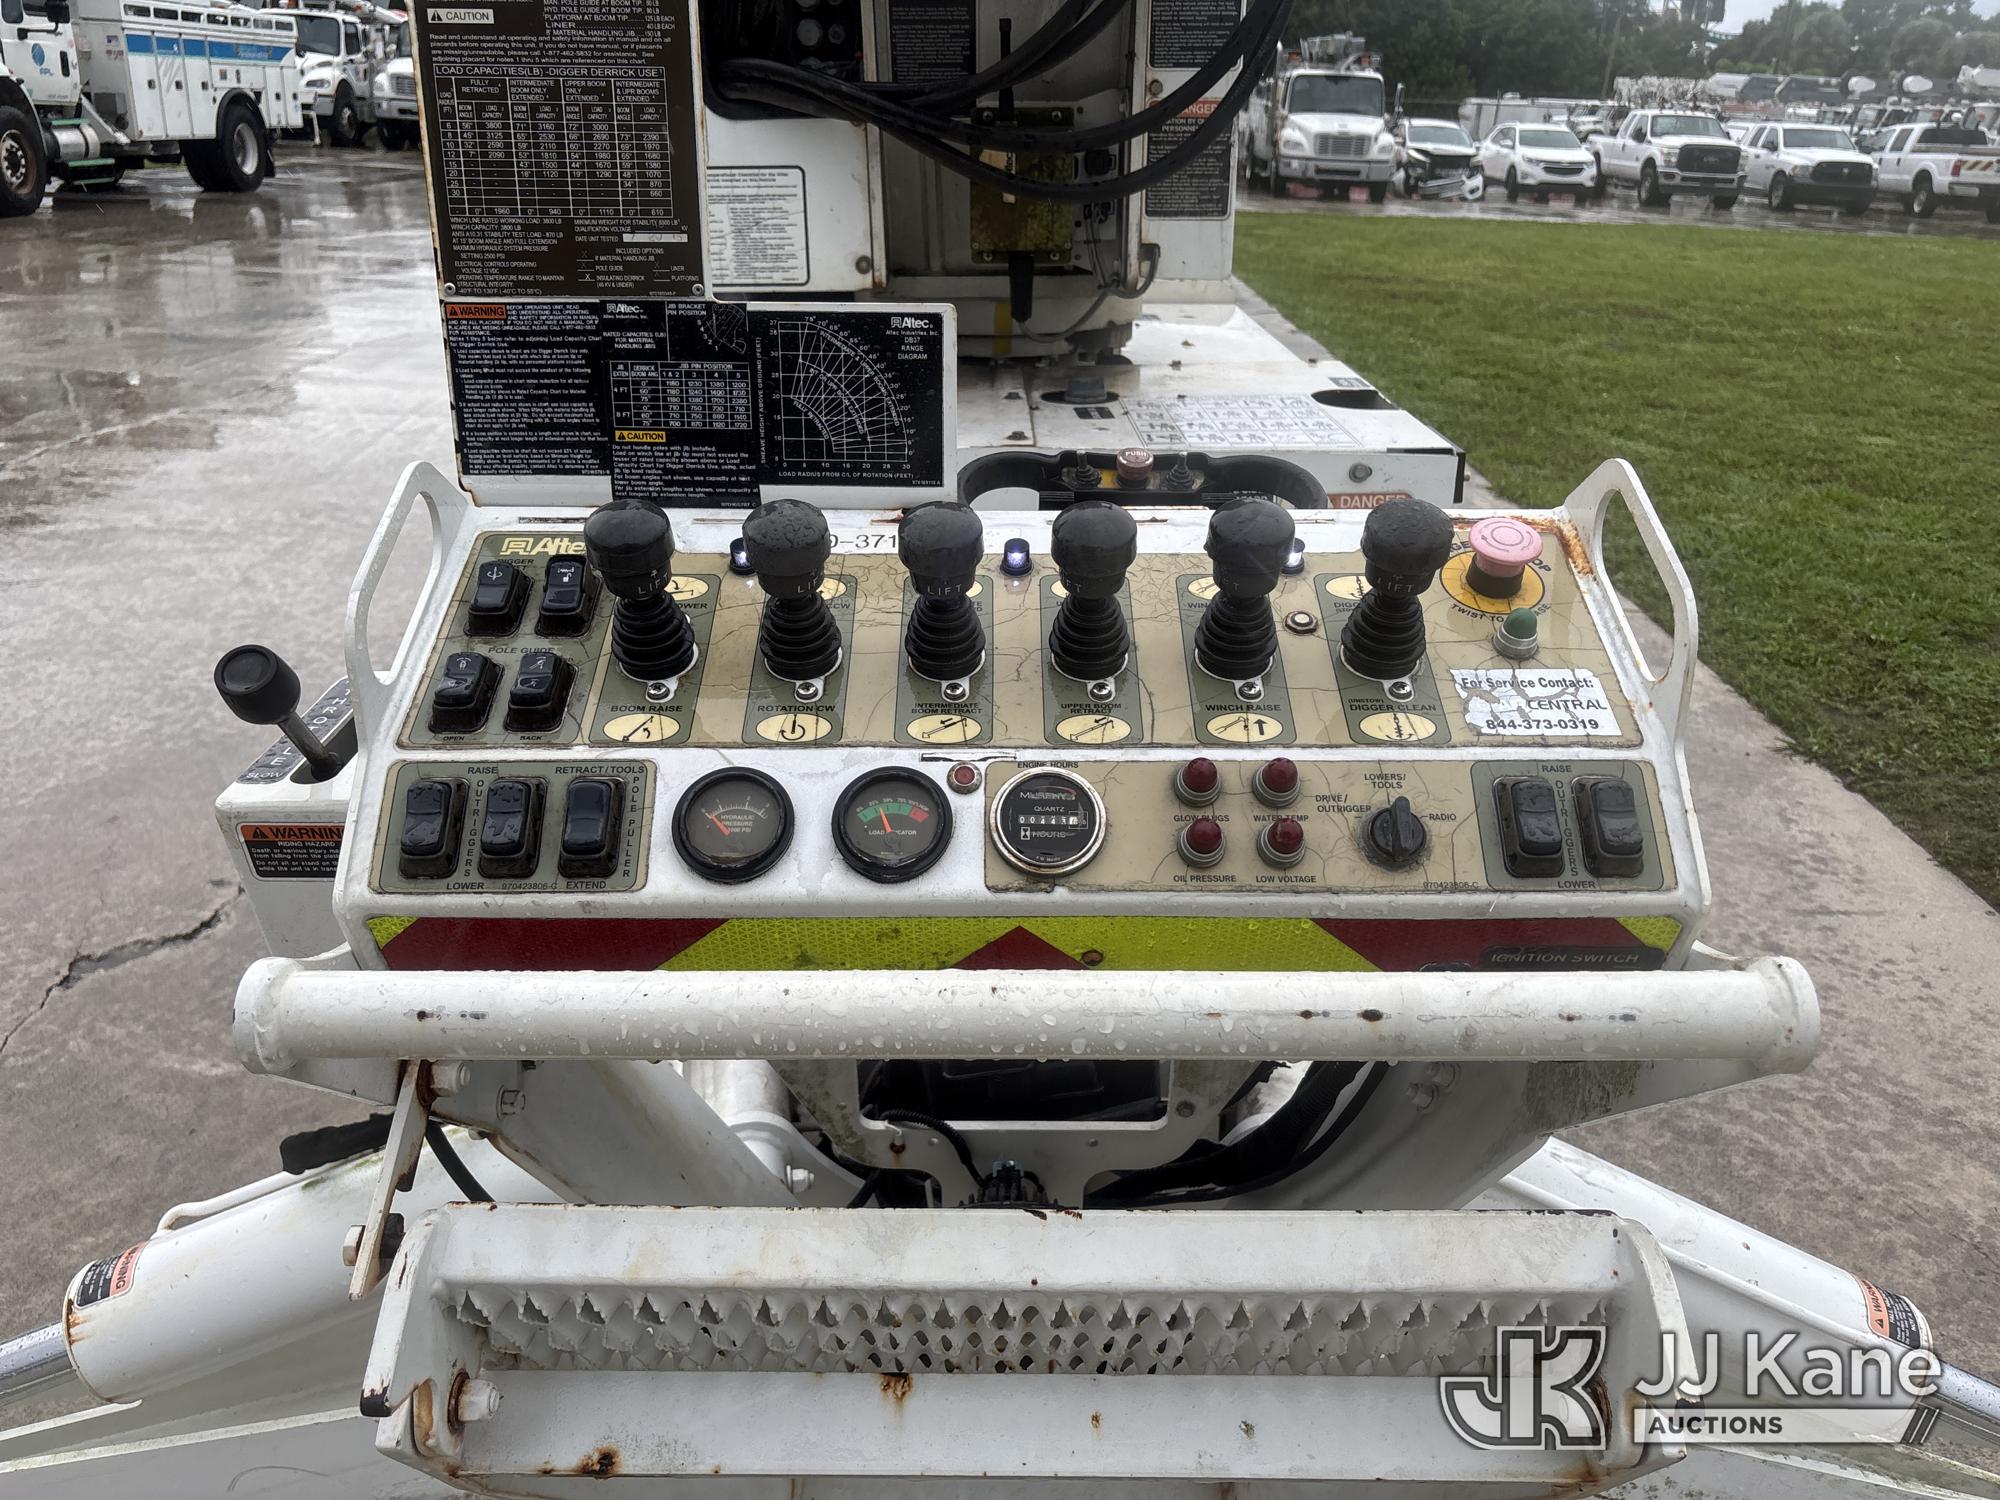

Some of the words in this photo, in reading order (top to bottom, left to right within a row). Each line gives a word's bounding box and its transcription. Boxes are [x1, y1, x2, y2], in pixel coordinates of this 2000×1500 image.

[446, 11, 490, 21] CAUTION
[436, 67, 463, 75] LOAD
[466, 67, 544, 76] CAPACITIES(LB)
[546, 67, 588, 76] -DIGGER
[590, 67, 636, 76] DERRICK
[460, 306, 504, 316] WARNING
[616, 304, 640, 312] Altec
[902, 318, 930, 328] Altec
[1126, 450, 1148, 458] PUSH
[530, 537, 588, 556] Alte
[638, 573, 672, 594] LIFT
[1376, 576, 1414, 592] LIFT
[927, 584, 962, 596] LIFT
[1451, 602, 1486, 620] TWIST
[1489, 614, 1504, 622] TO
[1462, 678, 1482, 688] For
[1540, 677, 1594, 688] Contact:
[1206, 704, 1242, 712] WINCH
[1246, 704, 1281, 712] RAISE
[1350, 704, 1394, 712] DIGGER
[1398, 704, 1436, 712] CLEAN
[1527, 700, 1607, 710] CENTRAL
[1486, 719, 1600, 730] 844-373-0319
[468, 766, 498, 774] RAISE
[1372, 781, 1403, 789] TOOLS
[630, 776, 640, 812] POLE
[464, 780, 484, 877] OUTRIGGERS
[1556, 780, 1578, 876] OUTRIGGERS
[622, 819, 636, 878] PULLER
[446, 882, 484, 890] LOWER
[566, 881, 607, 890] EXTEND
[1558, 881, 1596, 889] LOWER
[1491, 954, 1567, 963] IGNITION
[1571, 954, 1639, 963] SWITCH
